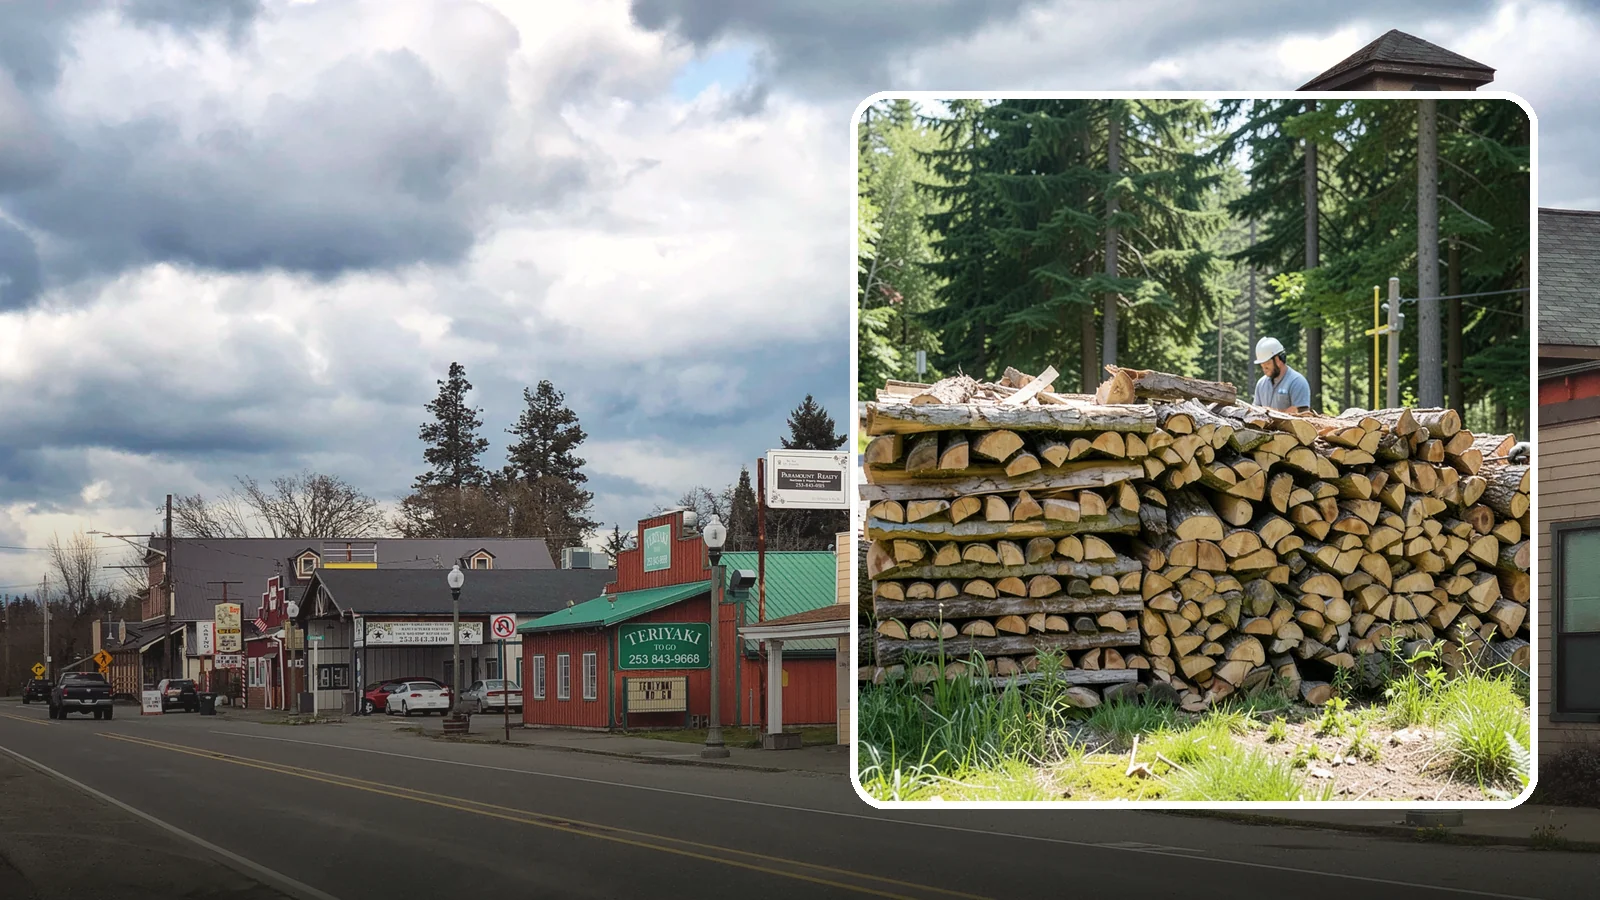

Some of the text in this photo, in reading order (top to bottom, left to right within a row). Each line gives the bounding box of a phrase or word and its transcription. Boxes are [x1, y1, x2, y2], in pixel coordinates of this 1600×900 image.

[625, 627, 702, 646] TERIYAKI
[629, 653, 700, 665] 253 843-9668
